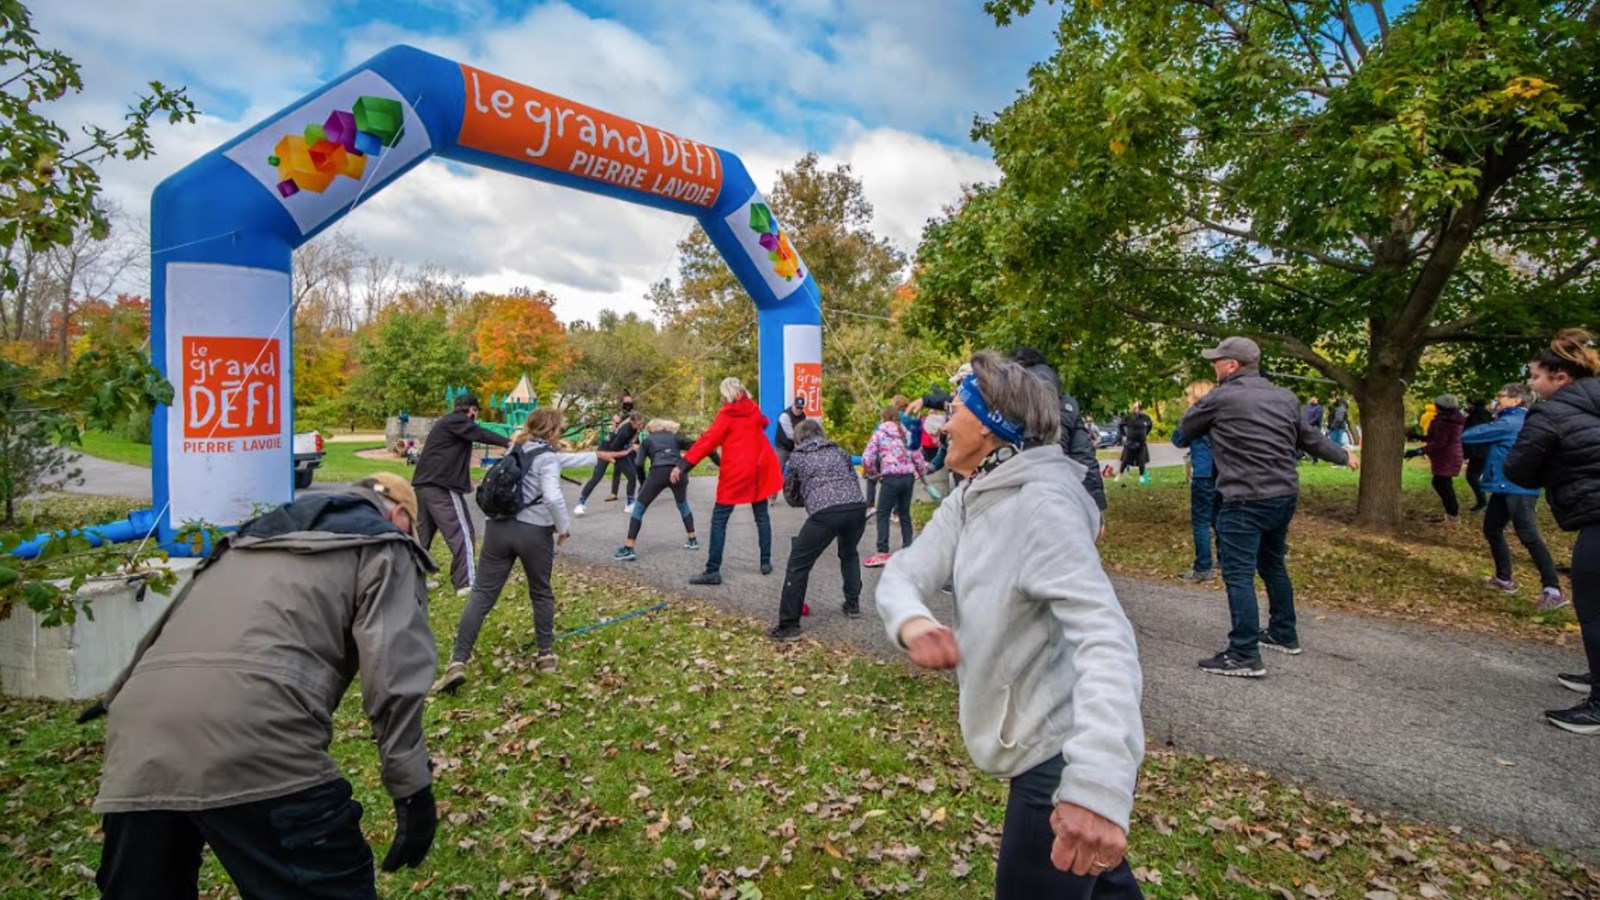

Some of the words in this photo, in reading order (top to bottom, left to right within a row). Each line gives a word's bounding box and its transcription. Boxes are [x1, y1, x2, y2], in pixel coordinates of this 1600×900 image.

[524, 99, 650, 164] grand
[569, 151, 648, 188] PIERRE
[651, 173, 715, 205] LAVOIE
[190, 351, 275, 384] grand
[797, 374, 822, 389] gran
[183, 441, 235, 453] PIERRE
[242, 437, 282, 452] LAVOIE
